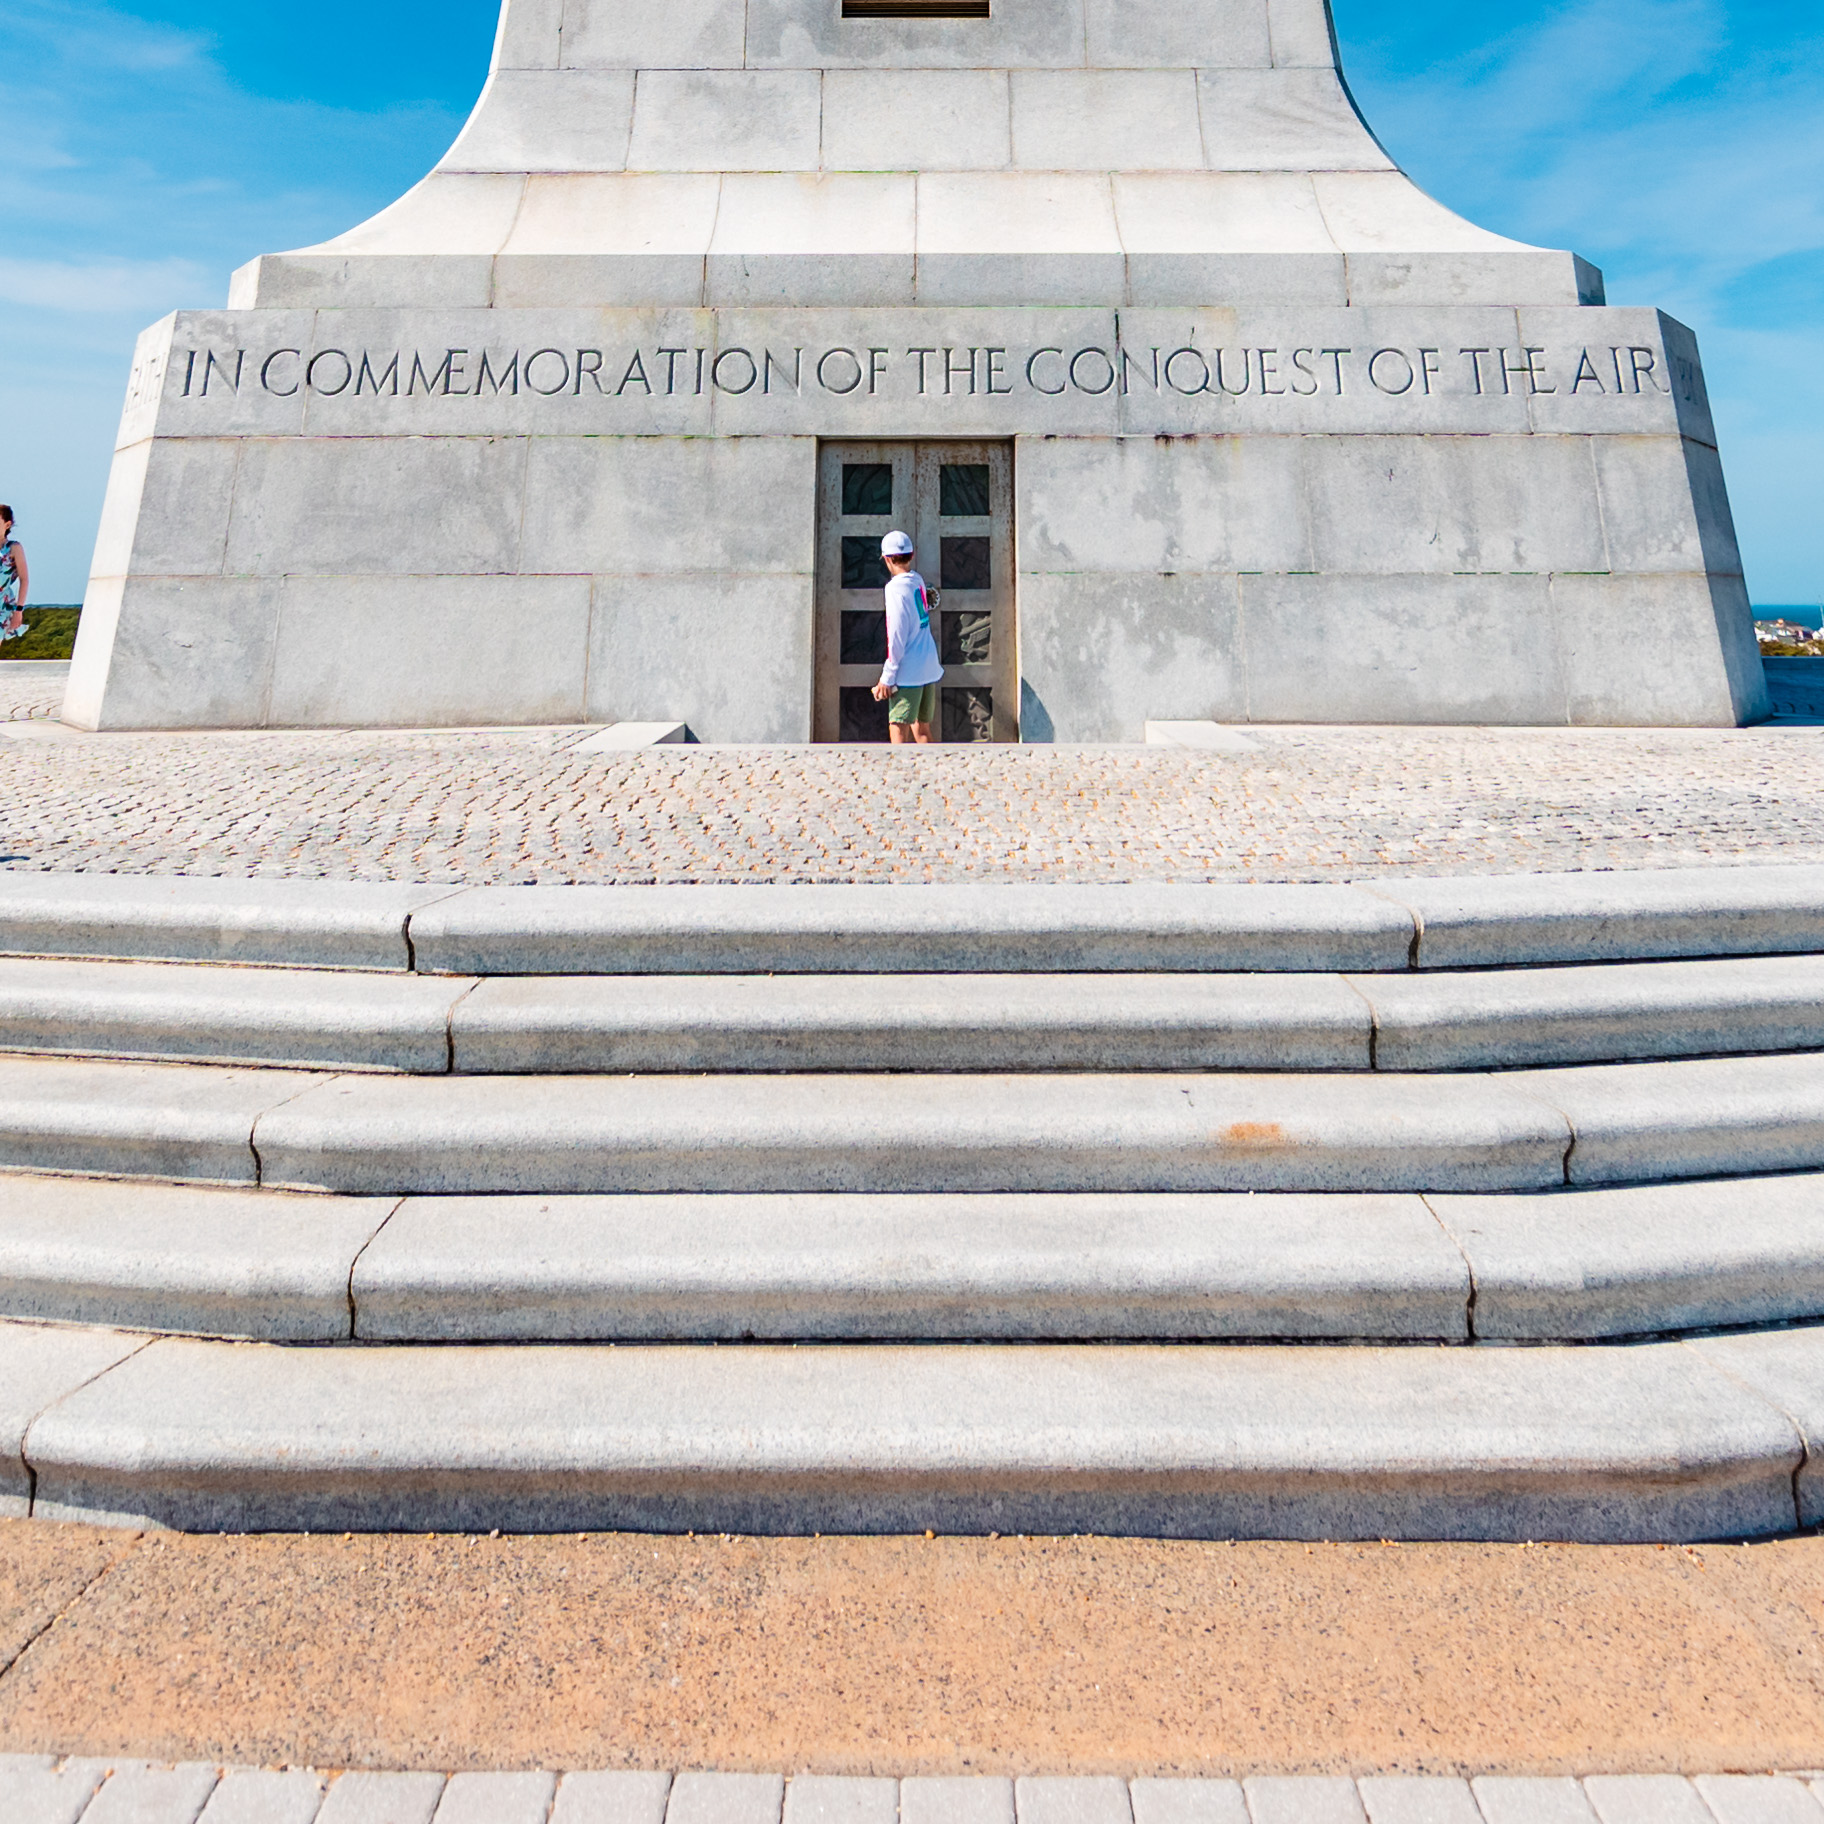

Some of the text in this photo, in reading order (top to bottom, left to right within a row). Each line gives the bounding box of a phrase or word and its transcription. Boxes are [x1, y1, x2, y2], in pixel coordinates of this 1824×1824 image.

[180, 348, 247, 397] IN
[259, 347, 803, 397] COMMEMORATION
[816, 347, 890, 396] OF
[906, 347, 1013, 395] THE
[1025, 346, 1352, 396] CONQUEST
[1367, 346, 1440, 396] OF
[1459, 346, 1557, 395] THE
[1572, 346, 1671, 395] AIR
